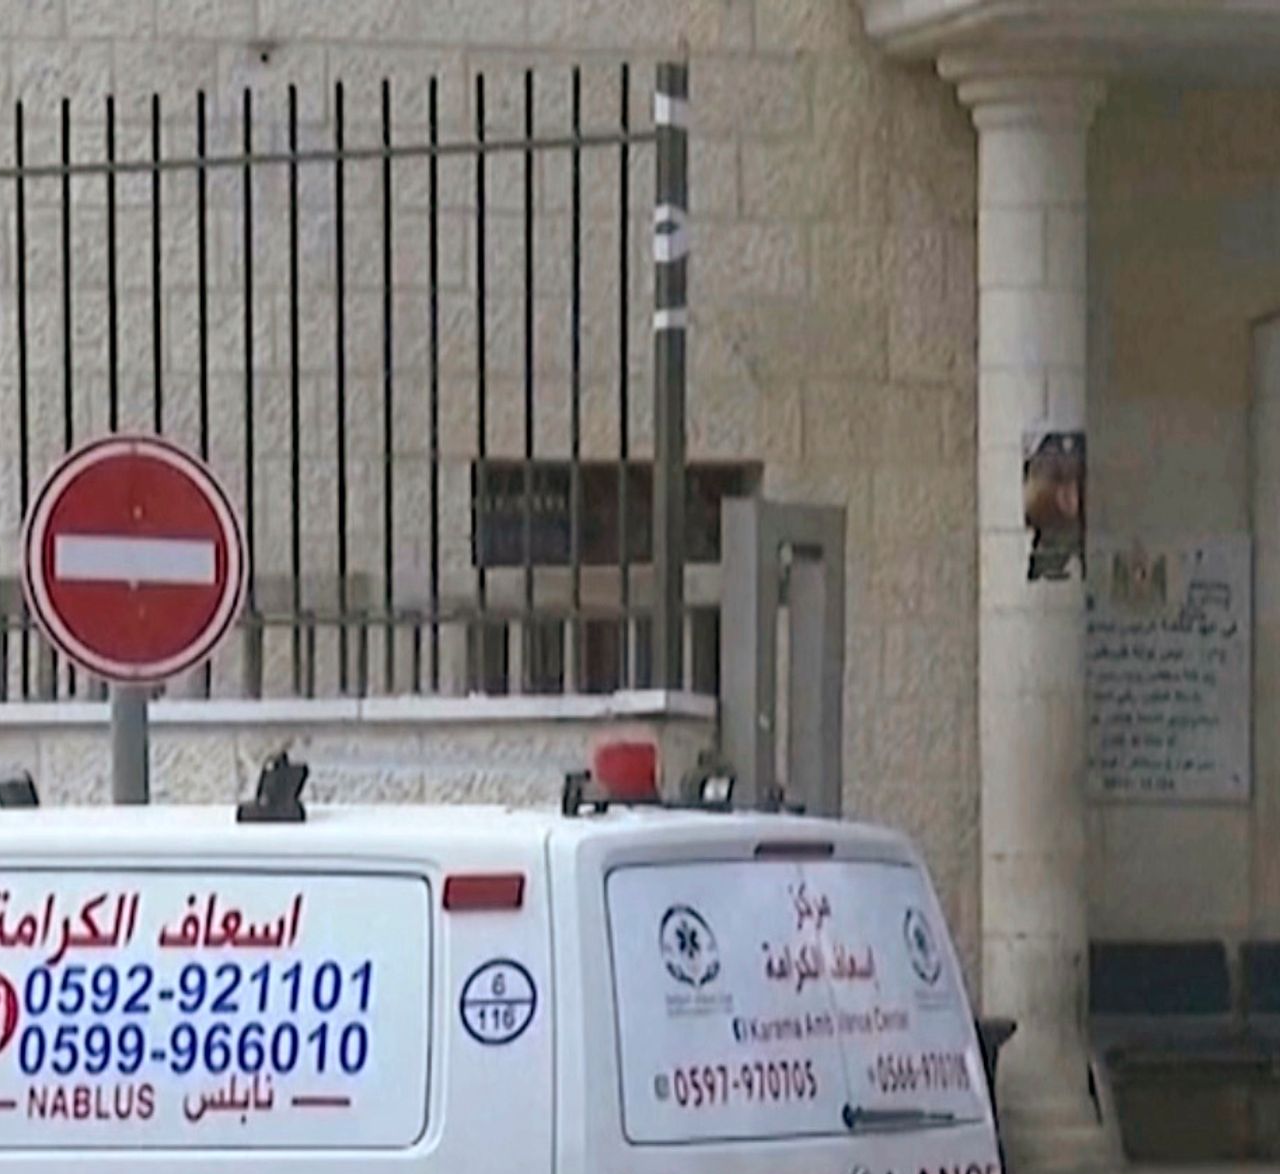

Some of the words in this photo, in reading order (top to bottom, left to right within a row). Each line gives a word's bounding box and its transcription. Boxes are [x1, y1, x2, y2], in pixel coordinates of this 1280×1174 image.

[158, 892, 303, 948] اسعاف
[23, 960, 373, 1016] 0592-921101
[19, 1021, 369, 1076] 0599-966010
[26, 1083, 155, 1120] NABLUS
[183, 1072, 274, 1125] نابلس
[673, 1060, 818, 1108] 0597-970705
